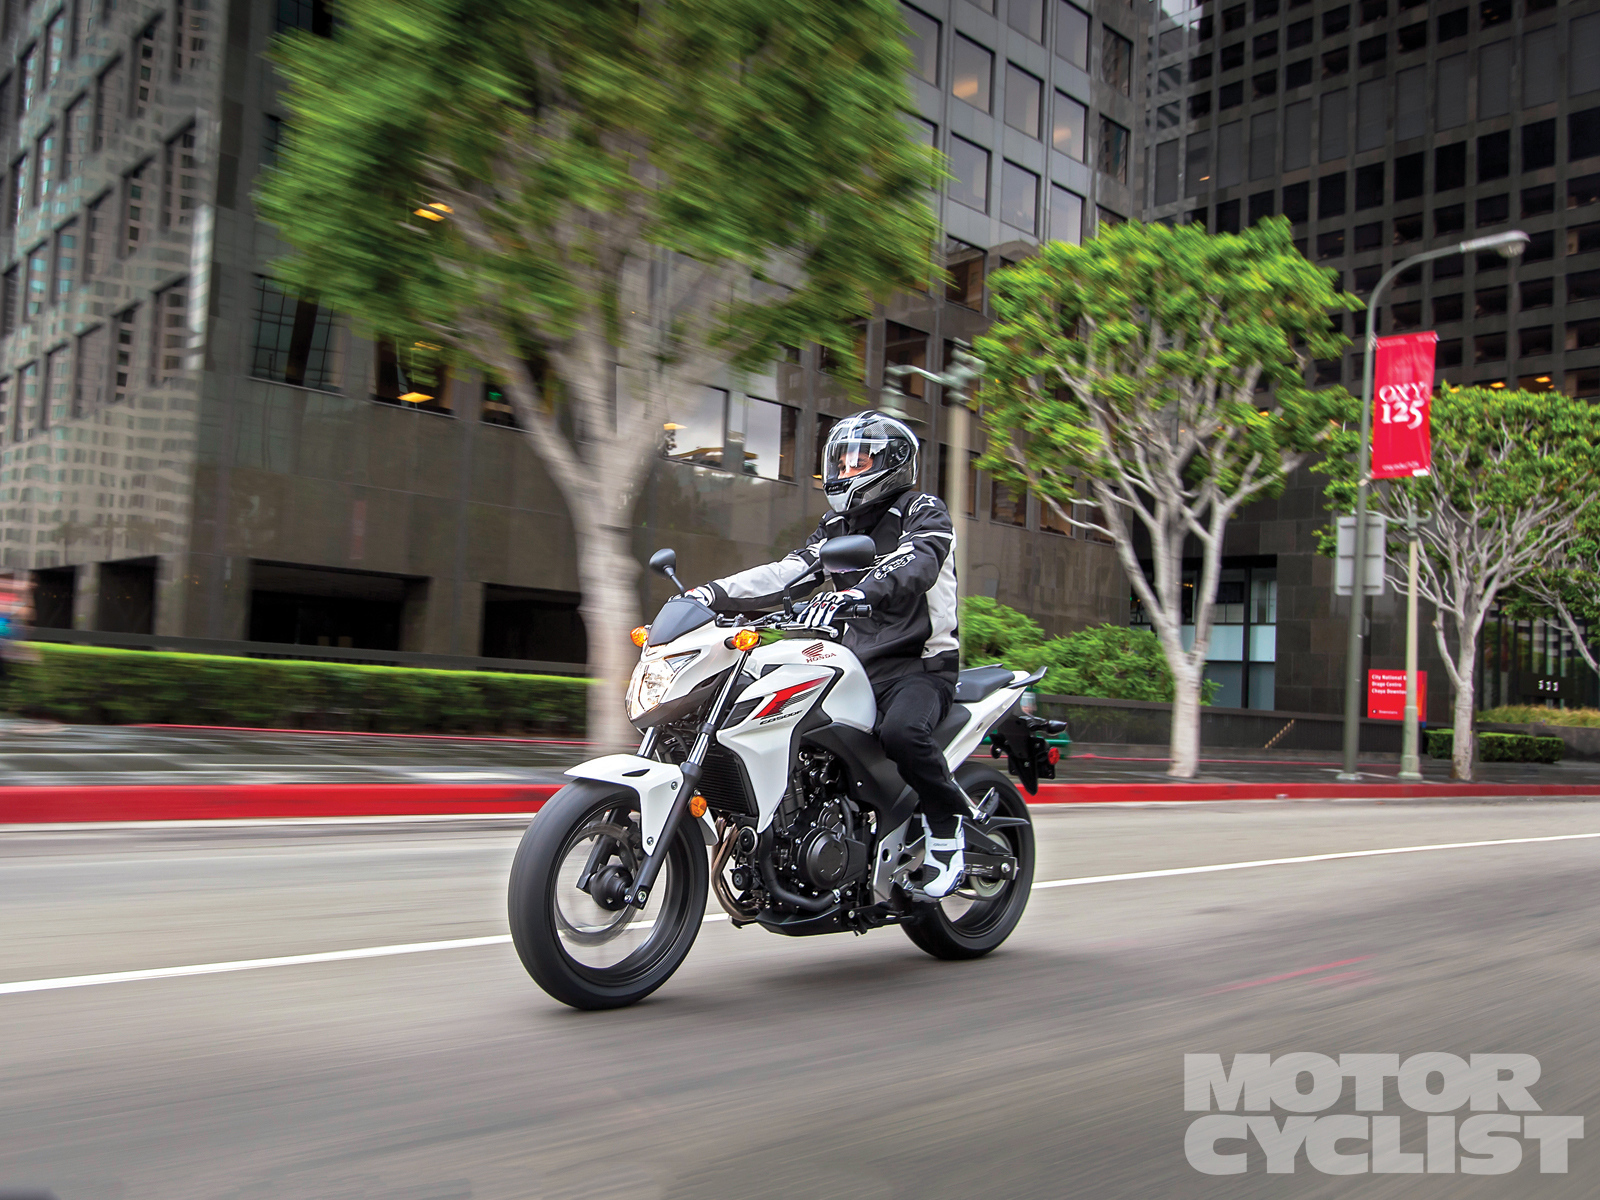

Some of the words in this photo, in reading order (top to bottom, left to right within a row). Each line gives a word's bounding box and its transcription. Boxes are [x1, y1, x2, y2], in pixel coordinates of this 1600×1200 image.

[1379, 381, 1426, 402] OXY
[1381, 399, 1424, 430] 125
[806, 653, 837, 663] HONDA
